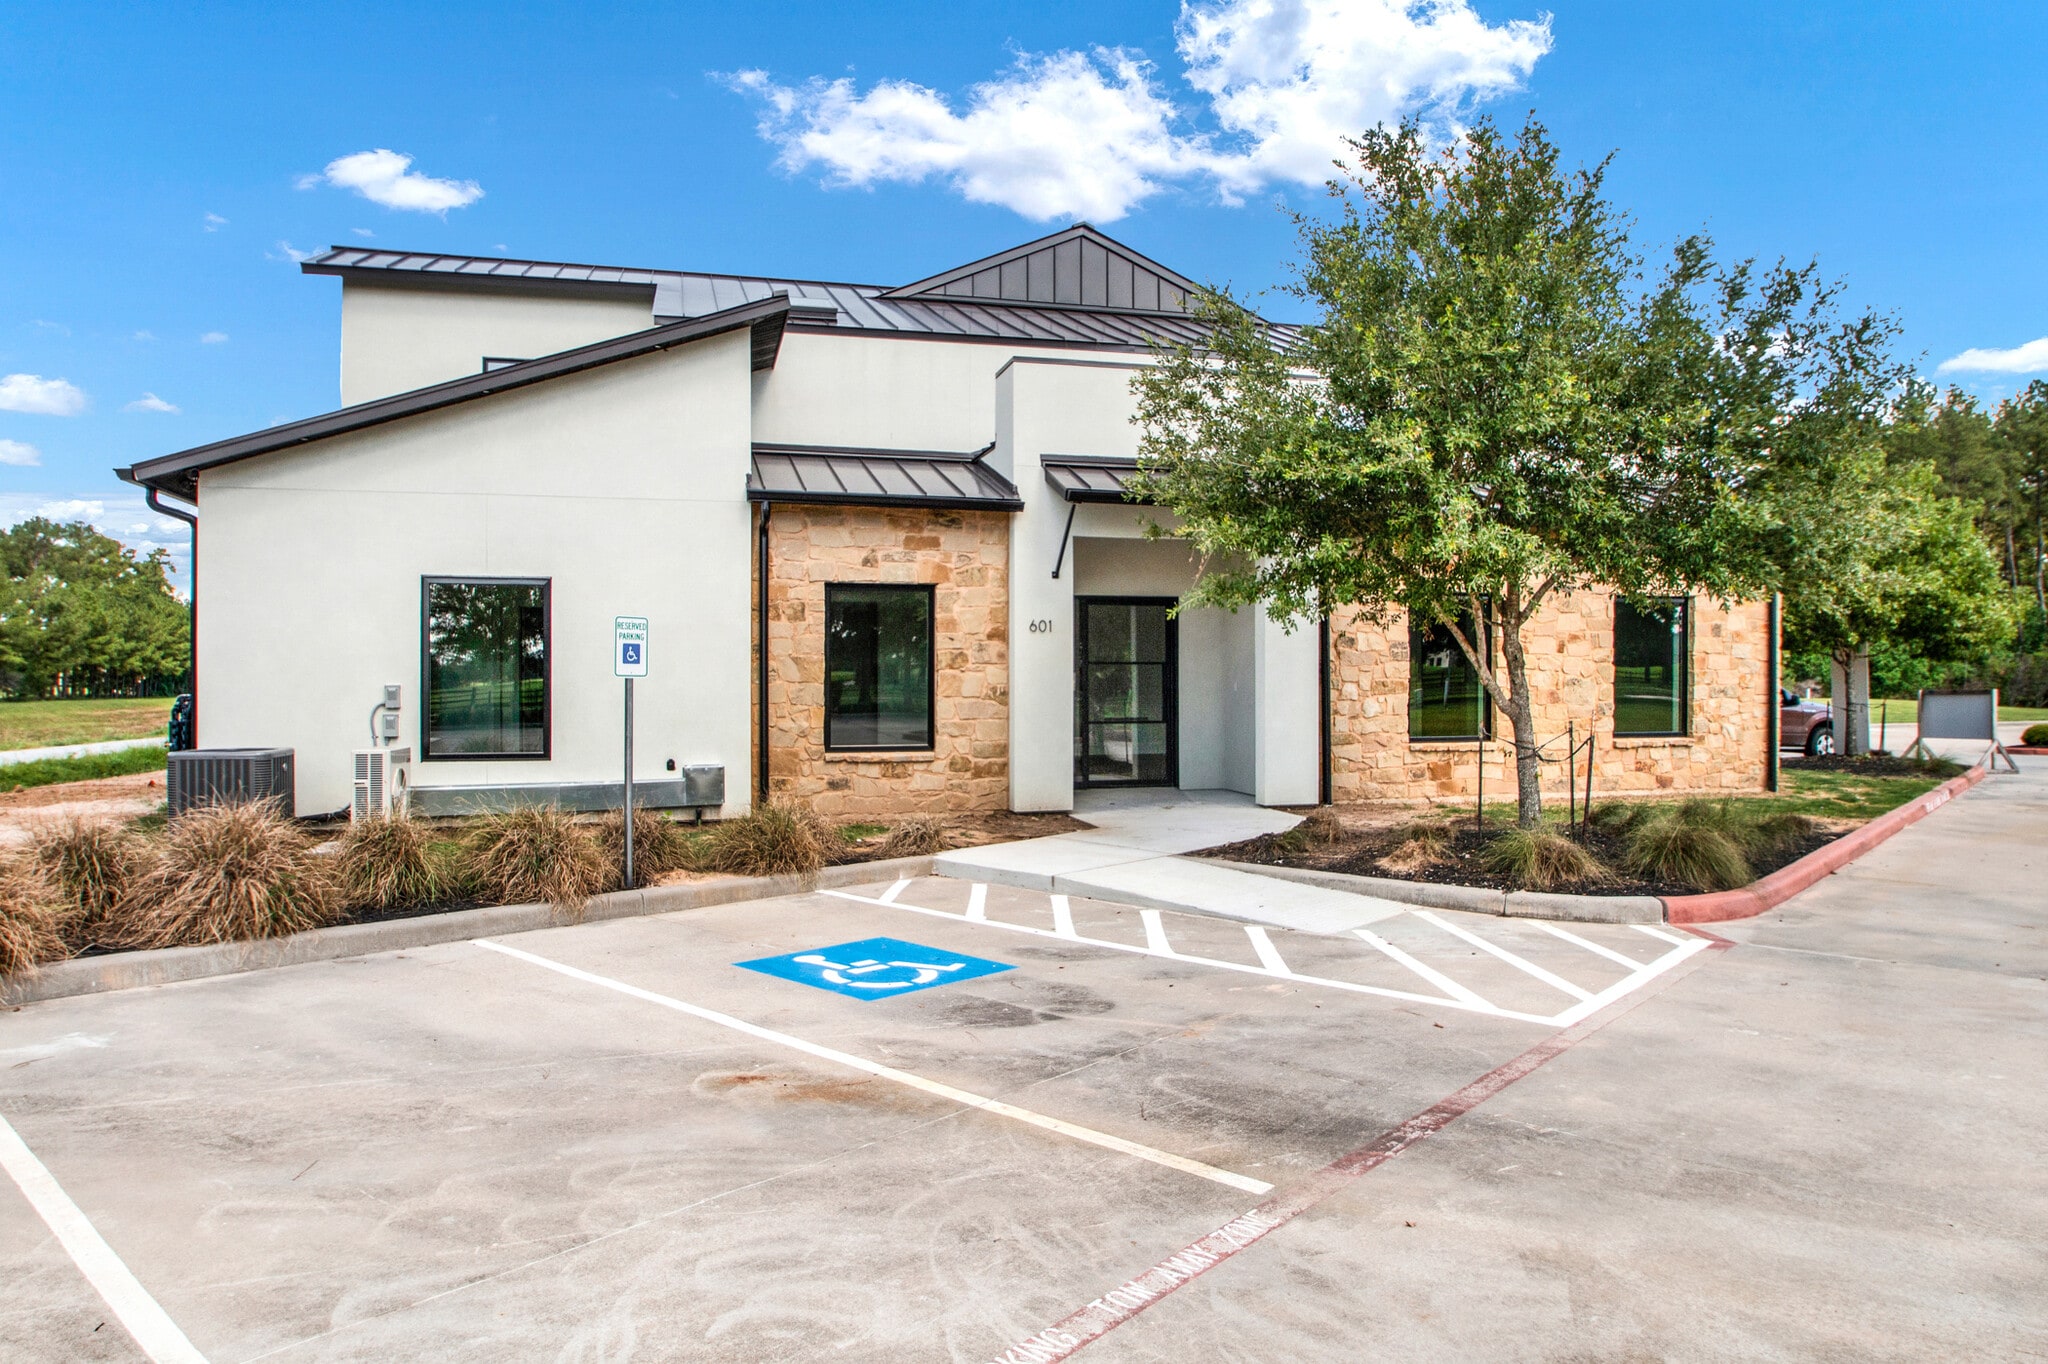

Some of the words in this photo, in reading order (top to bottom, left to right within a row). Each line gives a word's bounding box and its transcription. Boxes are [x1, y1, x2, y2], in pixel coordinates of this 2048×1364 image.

[617, 622, 647, 631] RESERVED
[1029, 619, 1052, 633] 601
[618, 632, 645, 641] PARKING
[983, 1328, 1079, 1364] KING
[1086, 1280, 1158, 1317] TOW
[1152, 1243, 1220, 1283] AWAY
[1208, 1208, 1281, 1249] ZONE
